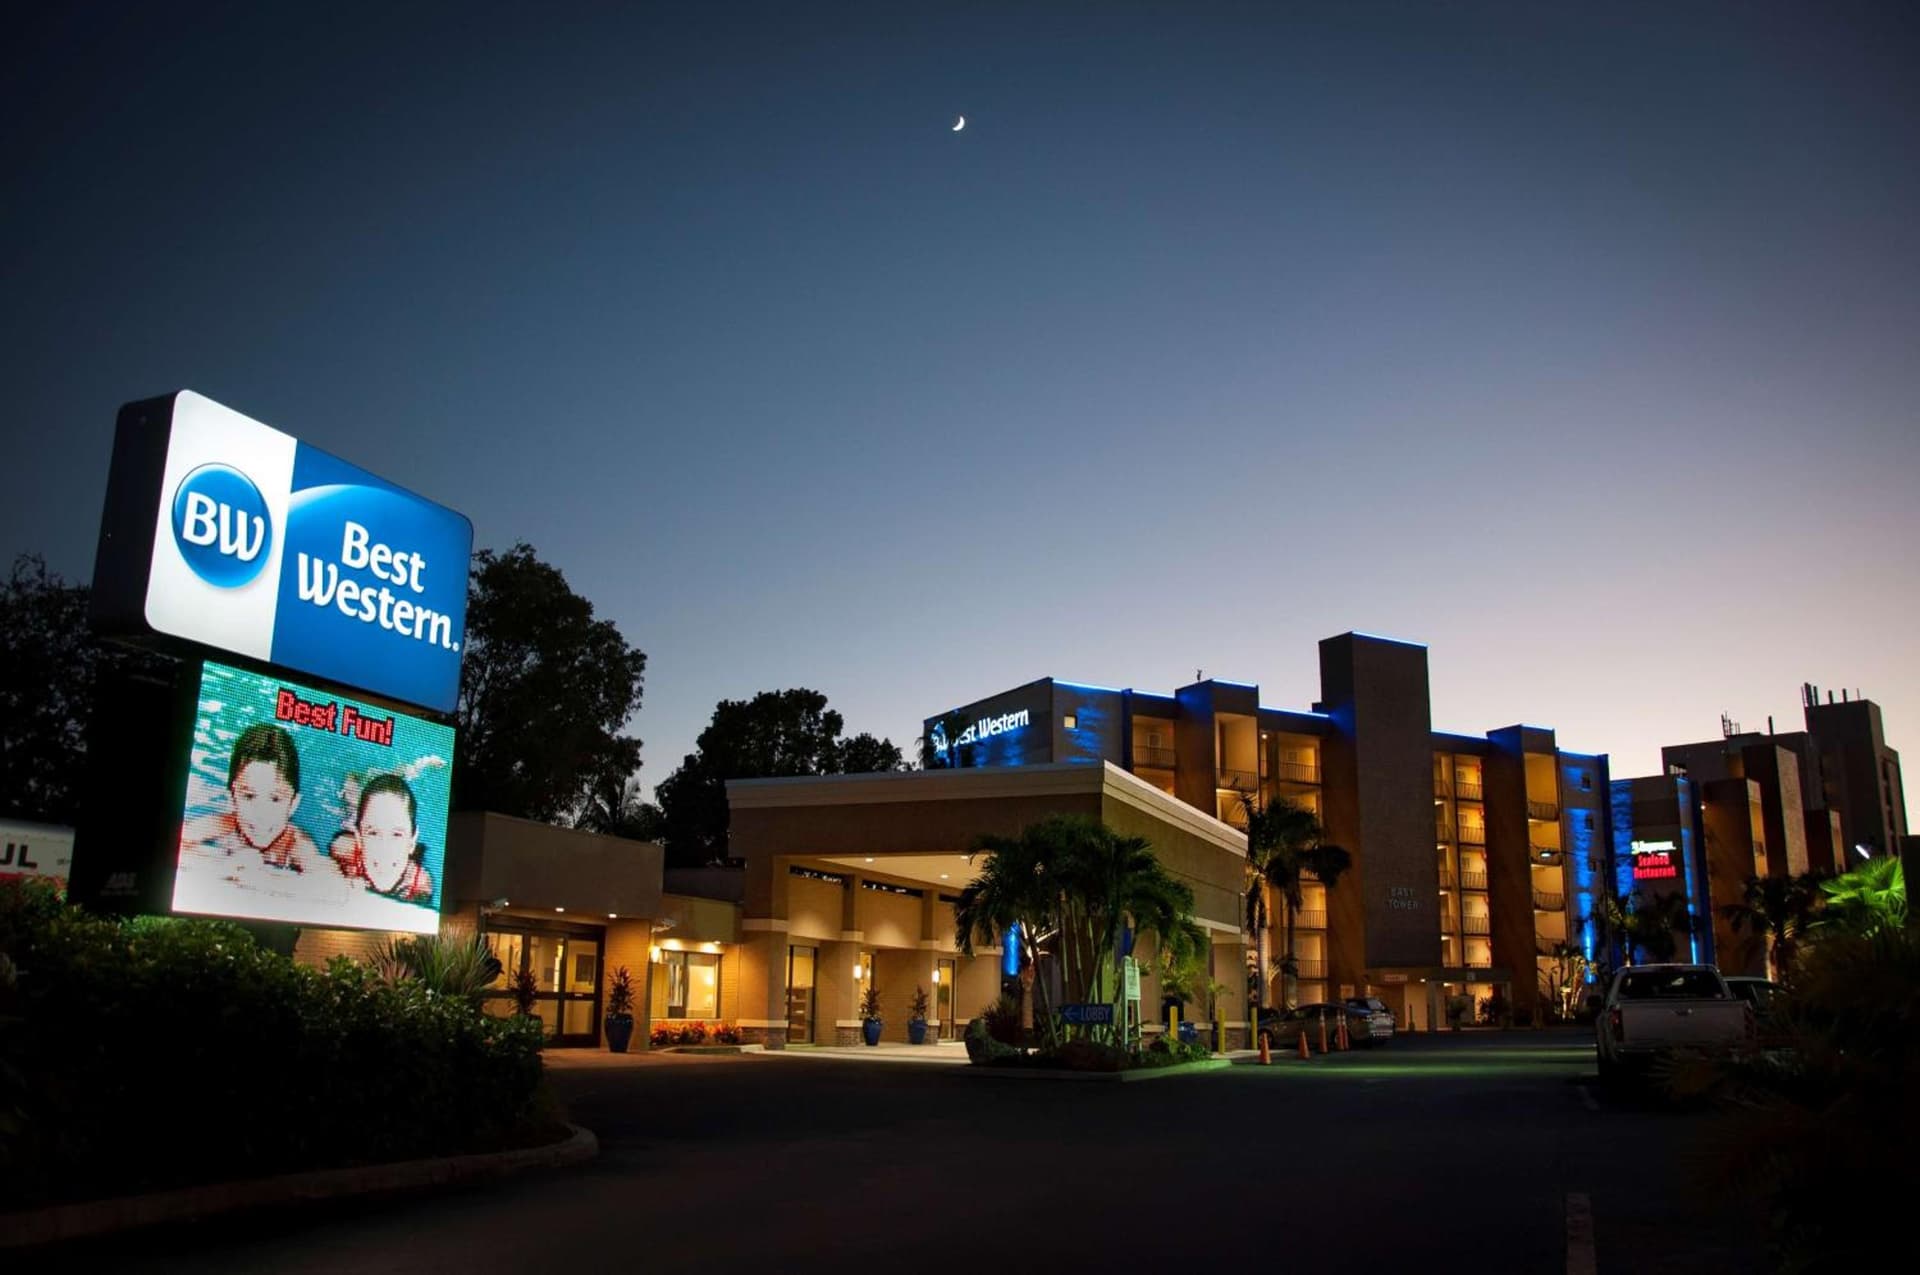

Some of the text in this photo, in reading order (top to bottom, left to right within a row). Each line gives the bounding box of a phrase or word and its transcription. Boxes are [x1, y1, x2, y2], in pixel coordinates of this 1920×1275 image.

[183, 491, 265, 562] BW
[341, 521, 426, 593] Best
[276, 688, 395, 746] Best Fun!
[979, 709, 1029, 739] Western
[1634, 866, 1676, 879] Restaurant
[1080, 1006, 1111, 1022] LOBBY
